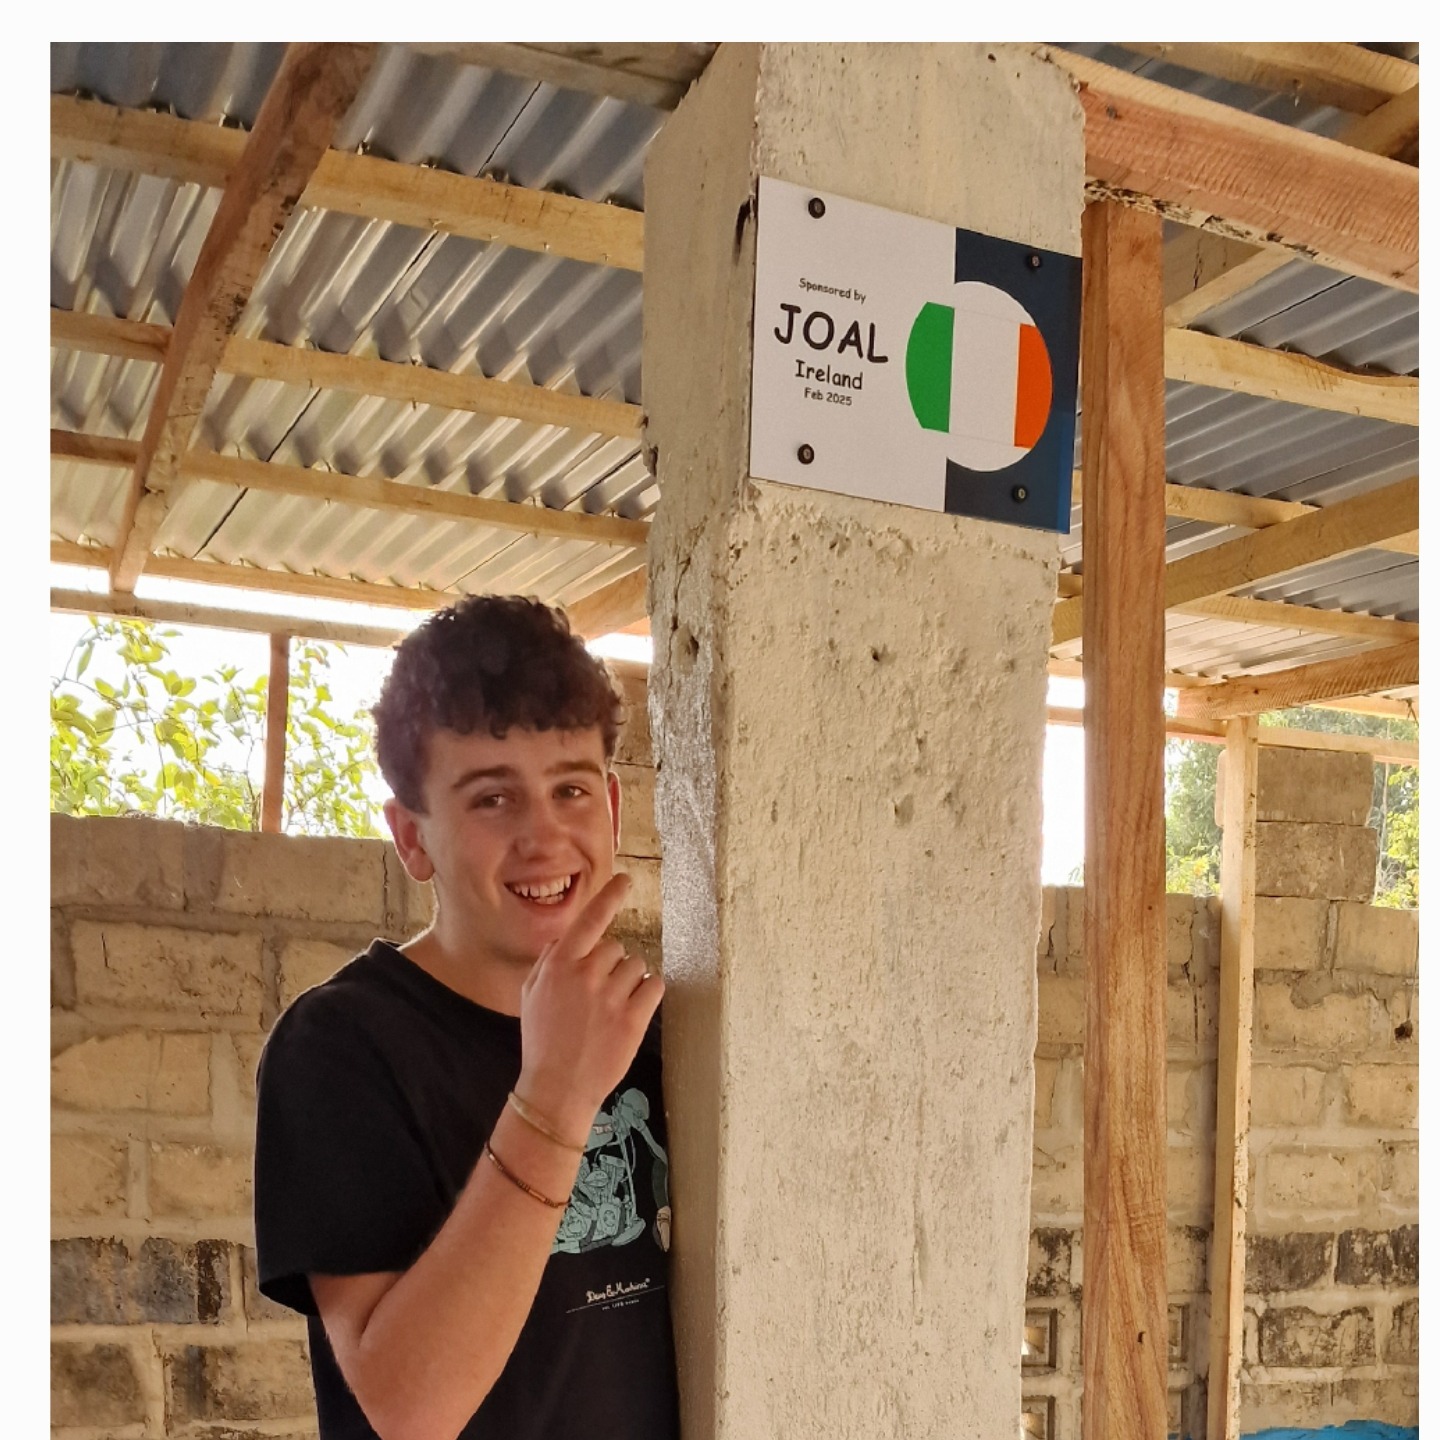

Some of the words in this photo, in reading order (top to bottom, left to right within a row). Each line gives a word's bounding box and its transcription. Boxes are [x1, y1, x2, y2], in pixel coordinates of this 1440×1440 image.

[799, 278, 851, 299] Sponsored
[854, 290, 866, 305] by
[774, 303, 888, 363] JOAL
[795, 359, 863, 390] Ireland
[804, 387, 823, 400] Feb
[826, 392, 852, 406] 2025
